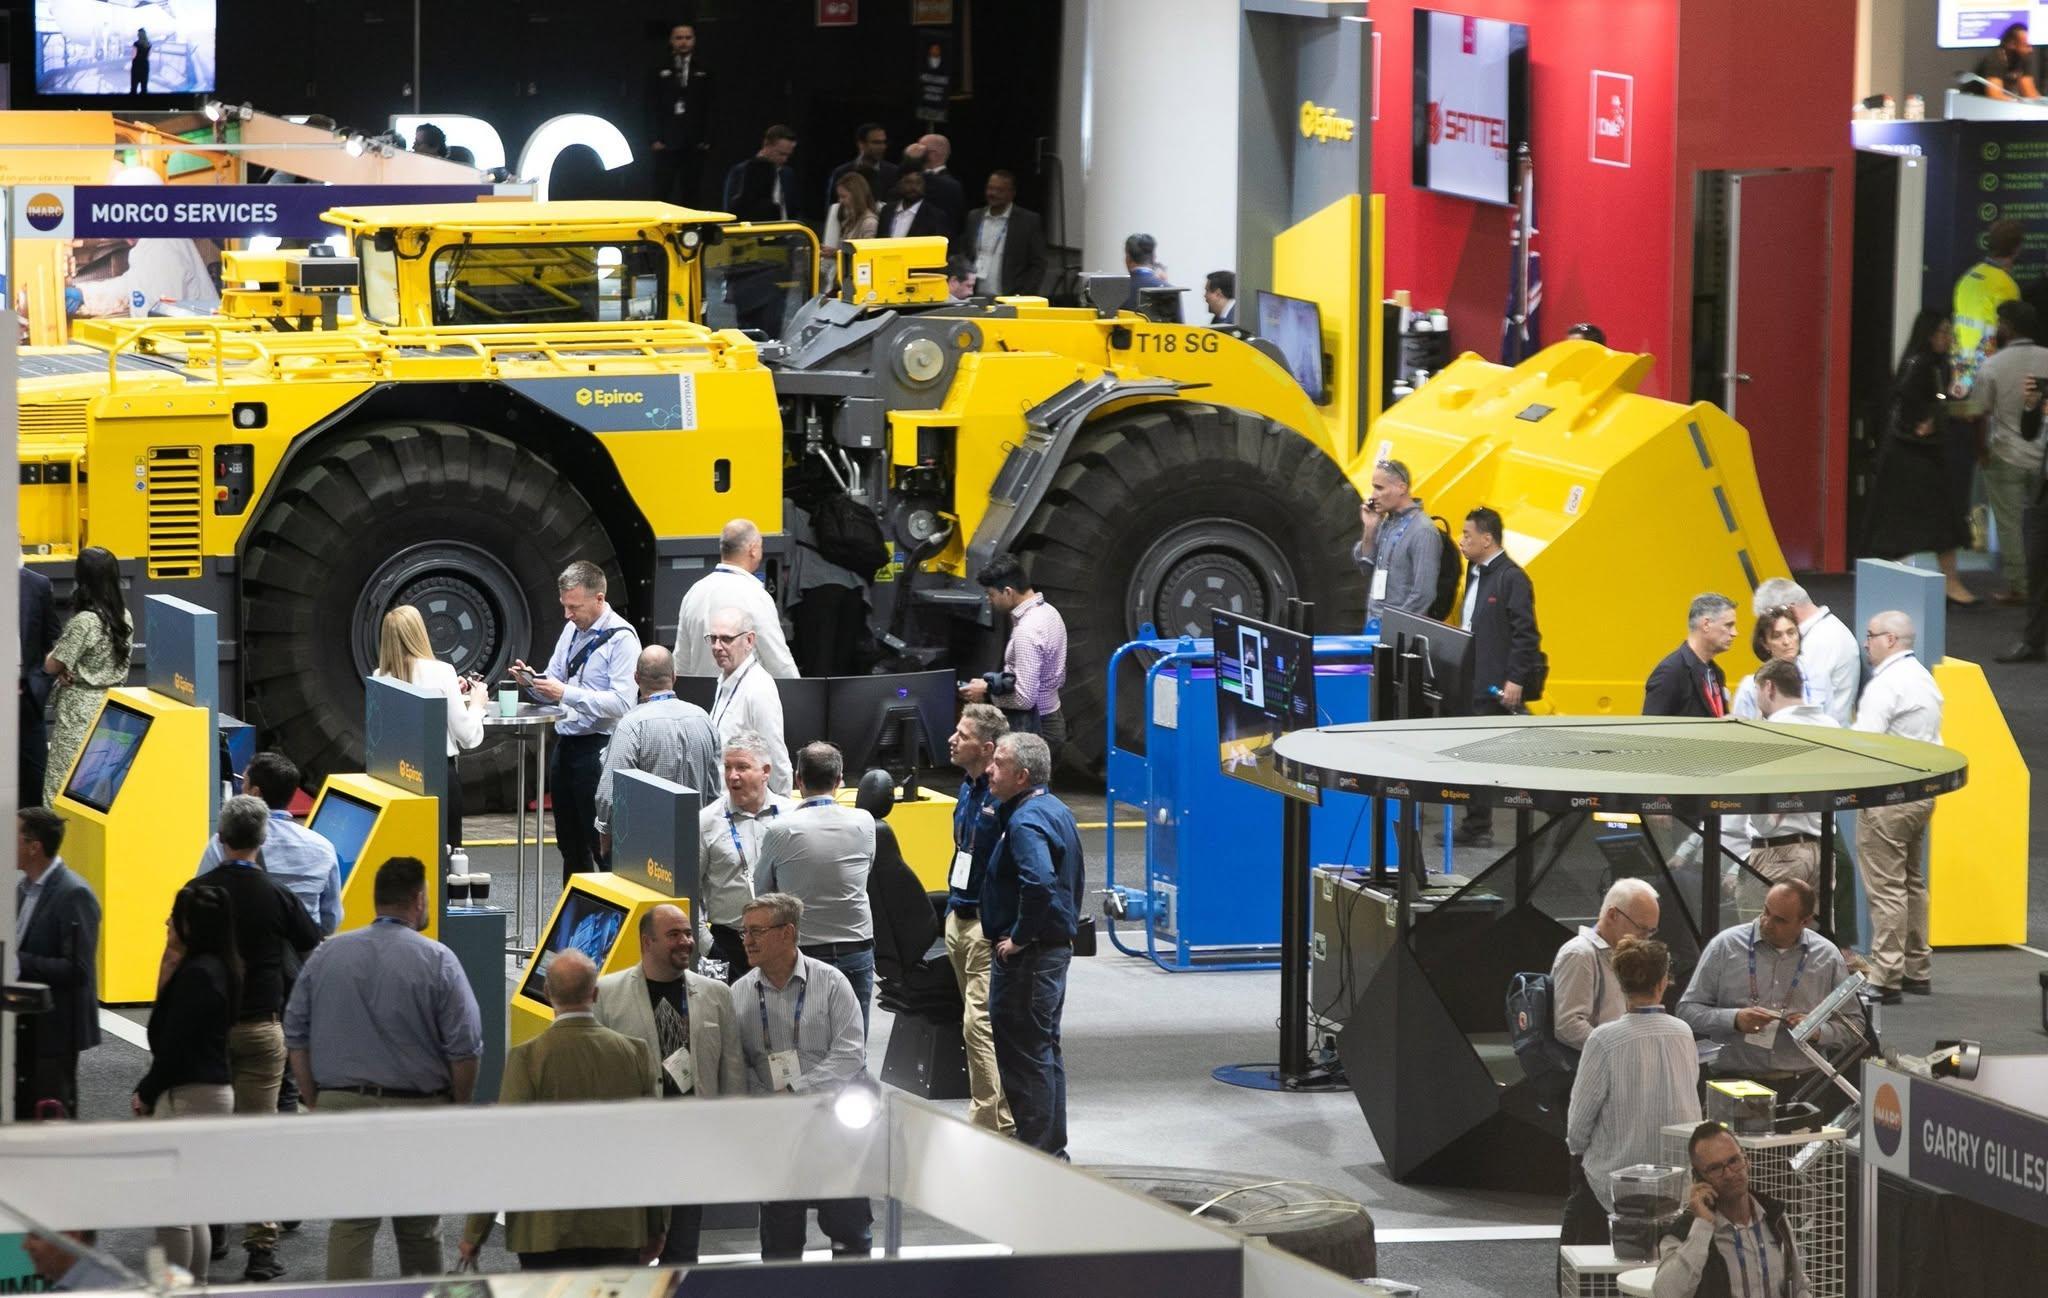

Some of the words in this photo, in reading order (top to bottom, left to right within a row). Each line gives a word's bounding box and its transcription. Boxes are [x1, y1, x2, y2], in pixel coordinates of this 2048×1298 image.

[1314, 106, 1355, 144] Epiroc
[1446, 110, 1509, 150] SATTEL
[28, 206, 62, 217] IMARC
[92, 203, 168, 223] MORCO
[174, 203, 278, 223] SERVICES
[1136, 333, 1176, 353] T18
[1184, 333, 1218, 353] SG
[594, 388, 644, 408] Epiroc
[684, 375, 693, 427] SCOOPTRAM
[406, 763, 423, 783] Epiroc
[1386, 784, 1410, 796] radlink
[1449, 790, 1470, 800] Epiroc
[1504, 794, 1533, 805] radlink
[1642, 801, 1672, 810] radlink
[1719, 801, 1741, 810] Epiroc
[1777, 799, 1804, 809] radlink
[654, 861, 672, 883] Epiroc
[1875, 1105, 1901, 1130] IMARC
[1923, 1119, 1980, 1169] GARRY
